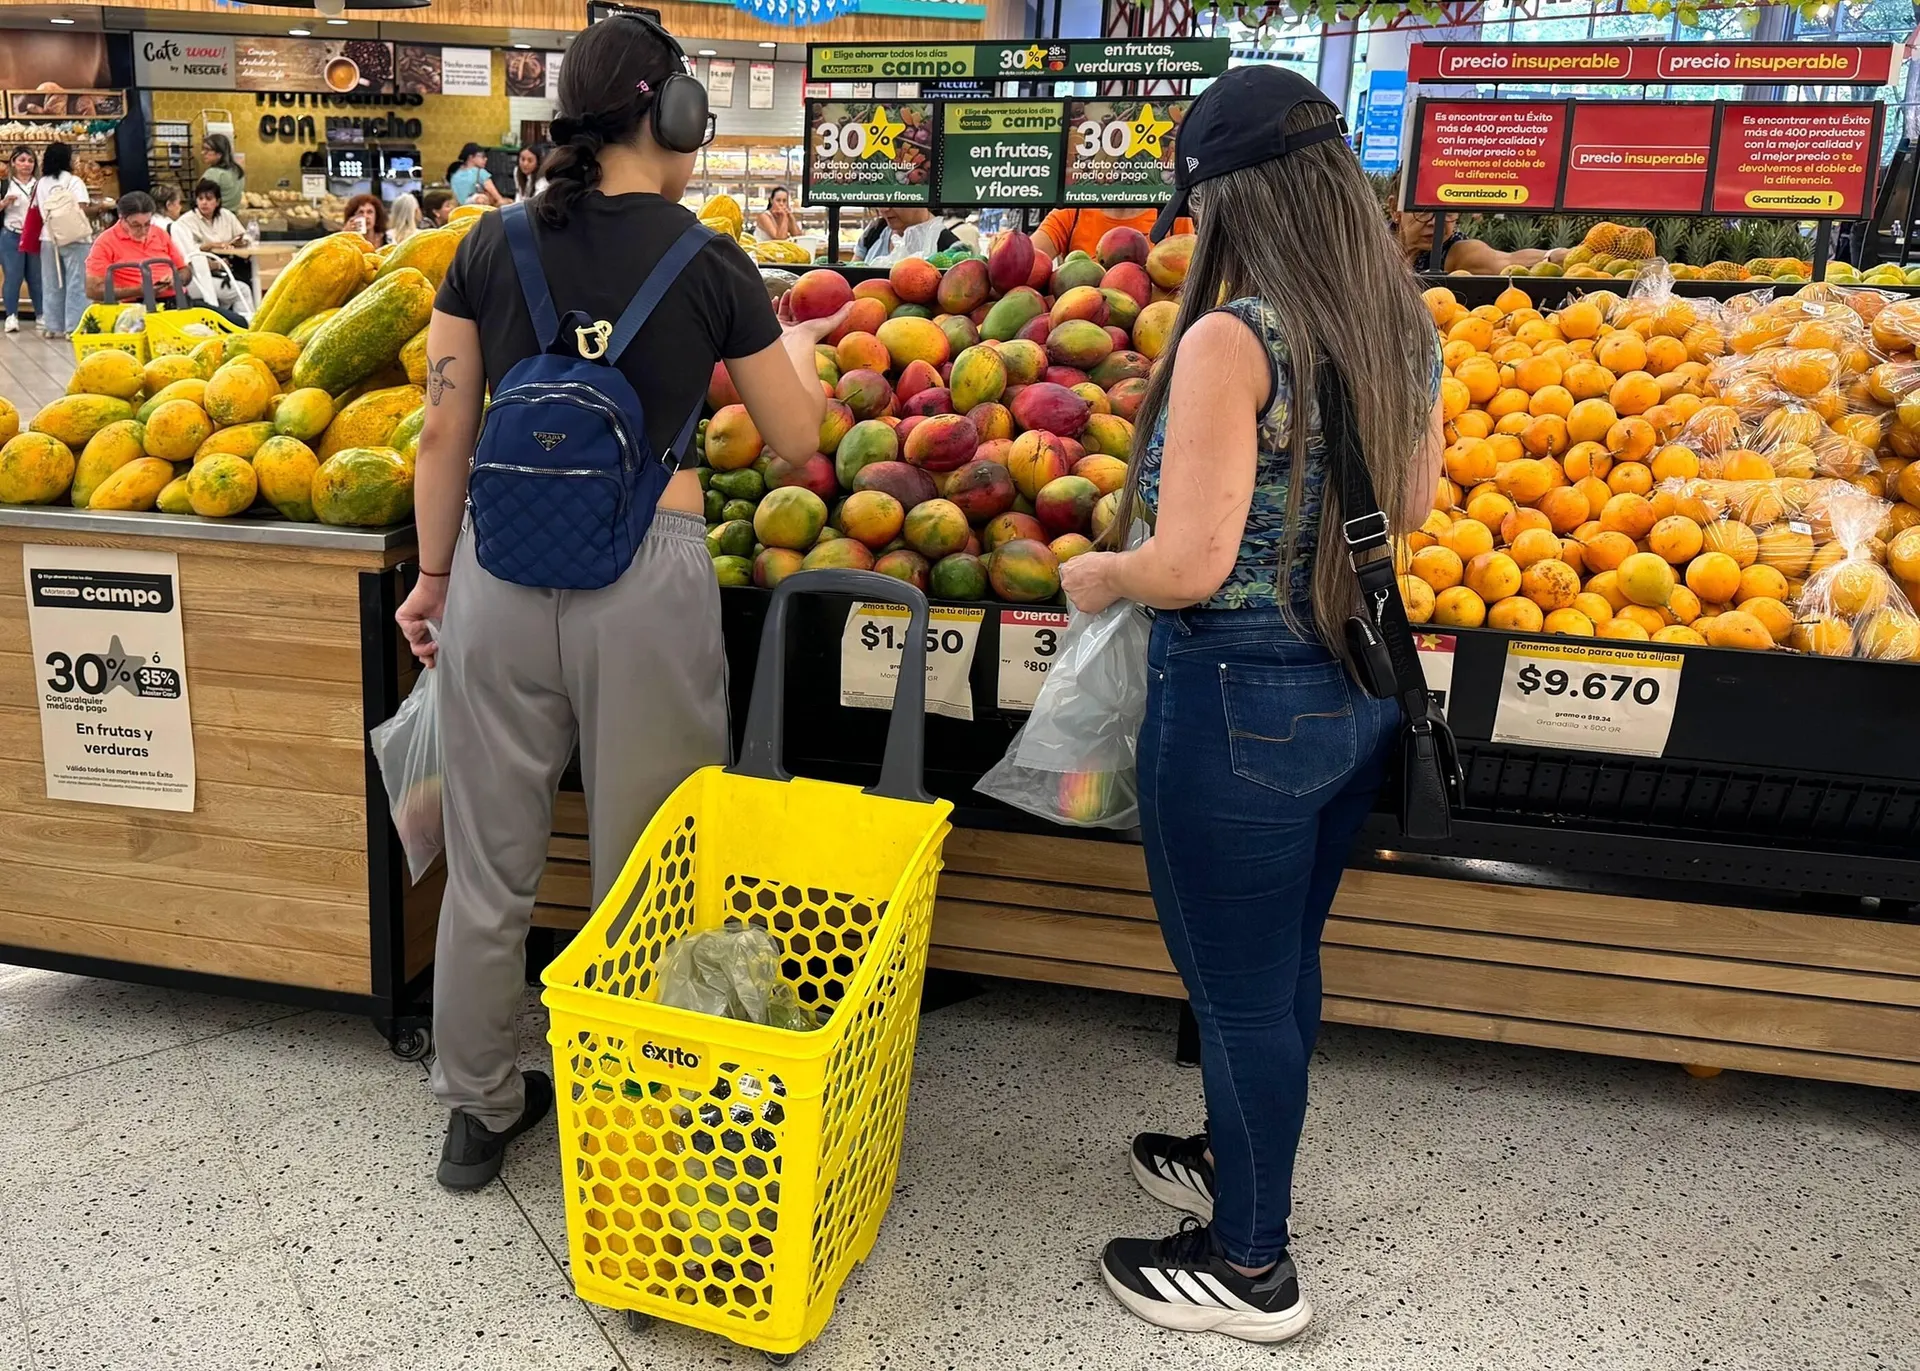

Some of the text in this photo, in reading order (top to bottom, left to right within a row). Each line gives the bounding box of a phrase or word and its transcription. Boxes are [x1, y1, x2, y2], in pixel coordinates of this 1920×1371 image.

[144, 39, 227, 62] Café wow!
[833, 48, 948, 60] Elige ahorrar todos los días
[1104, 43, 1175, 57] en frutas,
[1074, 59, 1203, 75] verduras y flores.
[1450, 52, 1621, 71] precio insuperable
[1669, 52, 1849, 71] precio insuperable
[183, 63, 228, 76] NESCAFÉ
[825, 60, 967, 77] Martes del campo
[1434, 111, 1553, 122] Es encontrar en tu Éxito
[1742, 114, 1871, 125] Es encontrar en tu Éxito
[259, 111, 423, 143] con mucho
[1436, 123, 1548, 135] más de 400 productos
[1744, 128, 1866, 139] más de 400 productos
[815, 122, 890, 158] 30%
[1075, 120, 1157, 157] 30%
[1436, 135, 1546, 147] con la mejor calidad y
[969, 141, 1053, 160] en frutas,
[1744, 140, 1863, 151] con la mejor calidad y
[1442, 147, 1453, 156] al
[1453, 147, 1483, 158] mejor
[1484, 147, 1517, 158] precio
[1525, 148, 1537, 157] te
[1580, 152, 1706, 166] precio insuperable
[1750, 152, 1853, 163] al mejor precio o te
[813, 160, 917, 171] de dcto con cualquier
[970, 161, 1051, 178] verduras
[1072, 159, 1133, 169] de dcto con
[1431, 158, 1546, 168] devolvemos el doble de
[1738, 163, 1863, 173] devolvemos el doble de
[813, 170, 884, 182] medio de pago
[1071, 170, 1149, 182] medio de pago
[1454, 170, 1519, 180] la diferencia.
[1763, 175, 1833, 185] la diferencia.
[808, 190, 924, 202] frutas, verduras y flores.
[974, 181, 1043, 200] y flores.
[1065, 191, 1157, 202] frutas, verduras y
[1444, 189, 1508, 199] Garantizado
[1752, 195, 1821, 204] Garantizado
[82, 586, 162, 608] campo
[886, 604, 906, 612] todo
[946, 607, 957, 615] tú
[957, 609, 983, 617] elijas!
[860, 620, 964, 654] $1.50
[152, 651, 161, 664] ó
[1512, 641, 1680, 662] ¡Tenemos todo para que tú elijas!
[1023, 659, 1052, 672] $80
[45, 651, 131, 695] 30%
[139, 668, 175, 686] 35%
[1516, 663, 1660, 705] $9.670
[45, 694, 104, 706] Con cualquier
[46, 702, 108, 714] medio de pago
[1587, 714, 1611, 722] $19.34
[76, 722, 153, 741] En frutas y
[1536, 718, 1580, 729] Granadilla
[1590, 724, 1607, 732] 500
[84, 743, 149, 757] verduras
[65, 764, 87, 773] Válido
[87, 766, 105, 774] todos
[105, 767, 115, 775] los
[116, 768, 139, 776] martes
[148, 770, 156, 778] tu
[156, 770, 174, 779] Éxito
[641, 1041, 699, 1069] éxito
